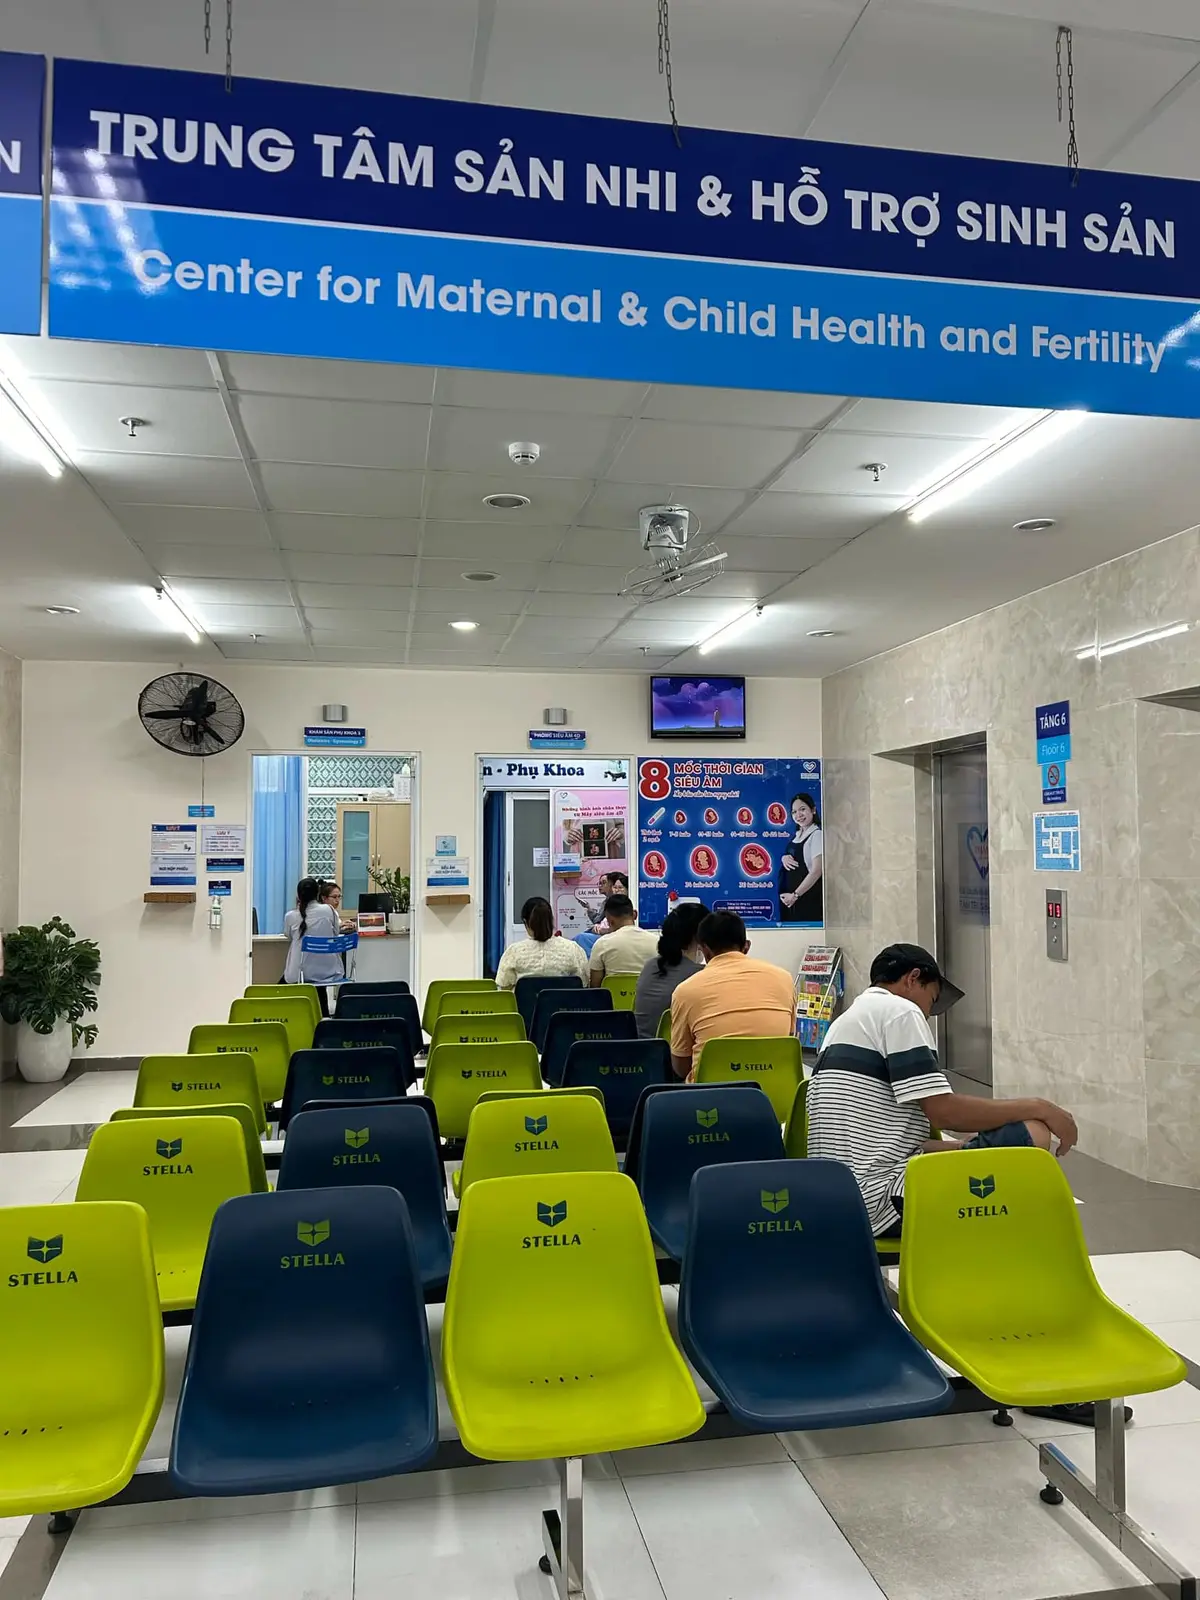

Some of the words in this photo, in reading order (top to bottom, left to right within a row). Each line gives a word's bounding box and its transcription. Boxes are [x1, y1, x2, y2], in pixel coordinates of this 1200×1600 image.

[90, 110, 295, 173] TRUNG
[314, 126, 434, 188] TÂM
[455, 138, 564, 201] SẢN
[586, 163, 676, 211] NHI
[697, 175, 731, 218] &
[752, 166, 828, 226] HỖ
[845, 190, 939, 247] TRỢ
[957, 201, 1067, 248] SINH
[1084, 203, 1175, 258] SẢN
[135, 249, 302, 298] Center
[317, 265, 381, 304] for
[397, 272, 601, 322] Maternal
[619, 291, 648, 327] &
[664, 295, 776, 338] Child
[793, 307, 925, 349] Health
[940, 324, 1017, 355] and
[1032, 326, 1166, 373] Fertility
[1061, 712, 1066, 725] 6
[1042, 744, 1059, 756] Floor
[1060, 742, 1065, 753] 6
[507, 764, 538, 781] Phụ
[543, 763, 584, 777] Khoa
[674, 761, 702, 775] MỐC
[703, 762, 732, 775] THỜI
[639, 759, 671, 801] 8
[674, 775, 700, 788] SIÊU
[702, 775, 722, 788] ÂM
[613, 1066, 643, 1074] STELLA
[744, 1063, 773, 1071] STELLA
[337, 1075, 370, 1084] STELLA
[476, 1070, 507, 1078] STELLA
[187, 1082, 221, 1091] STELLA
[687, 1132, 730, 1144] STELLA
[514, 1139, 559, 1152] STELLA
[332, 1153, 381, 1166] STELLA
[143, 1164, 193, 1176] STELLA
[957, 1205, 1009, 1219] STELLA
[748, 1220, 804, 1234] STELLA
[522, 1234, 581, 1249] STELLA
[280, 1253, 345, 1269] STELLA
[8, 1271, 78, 1287] STELLA
